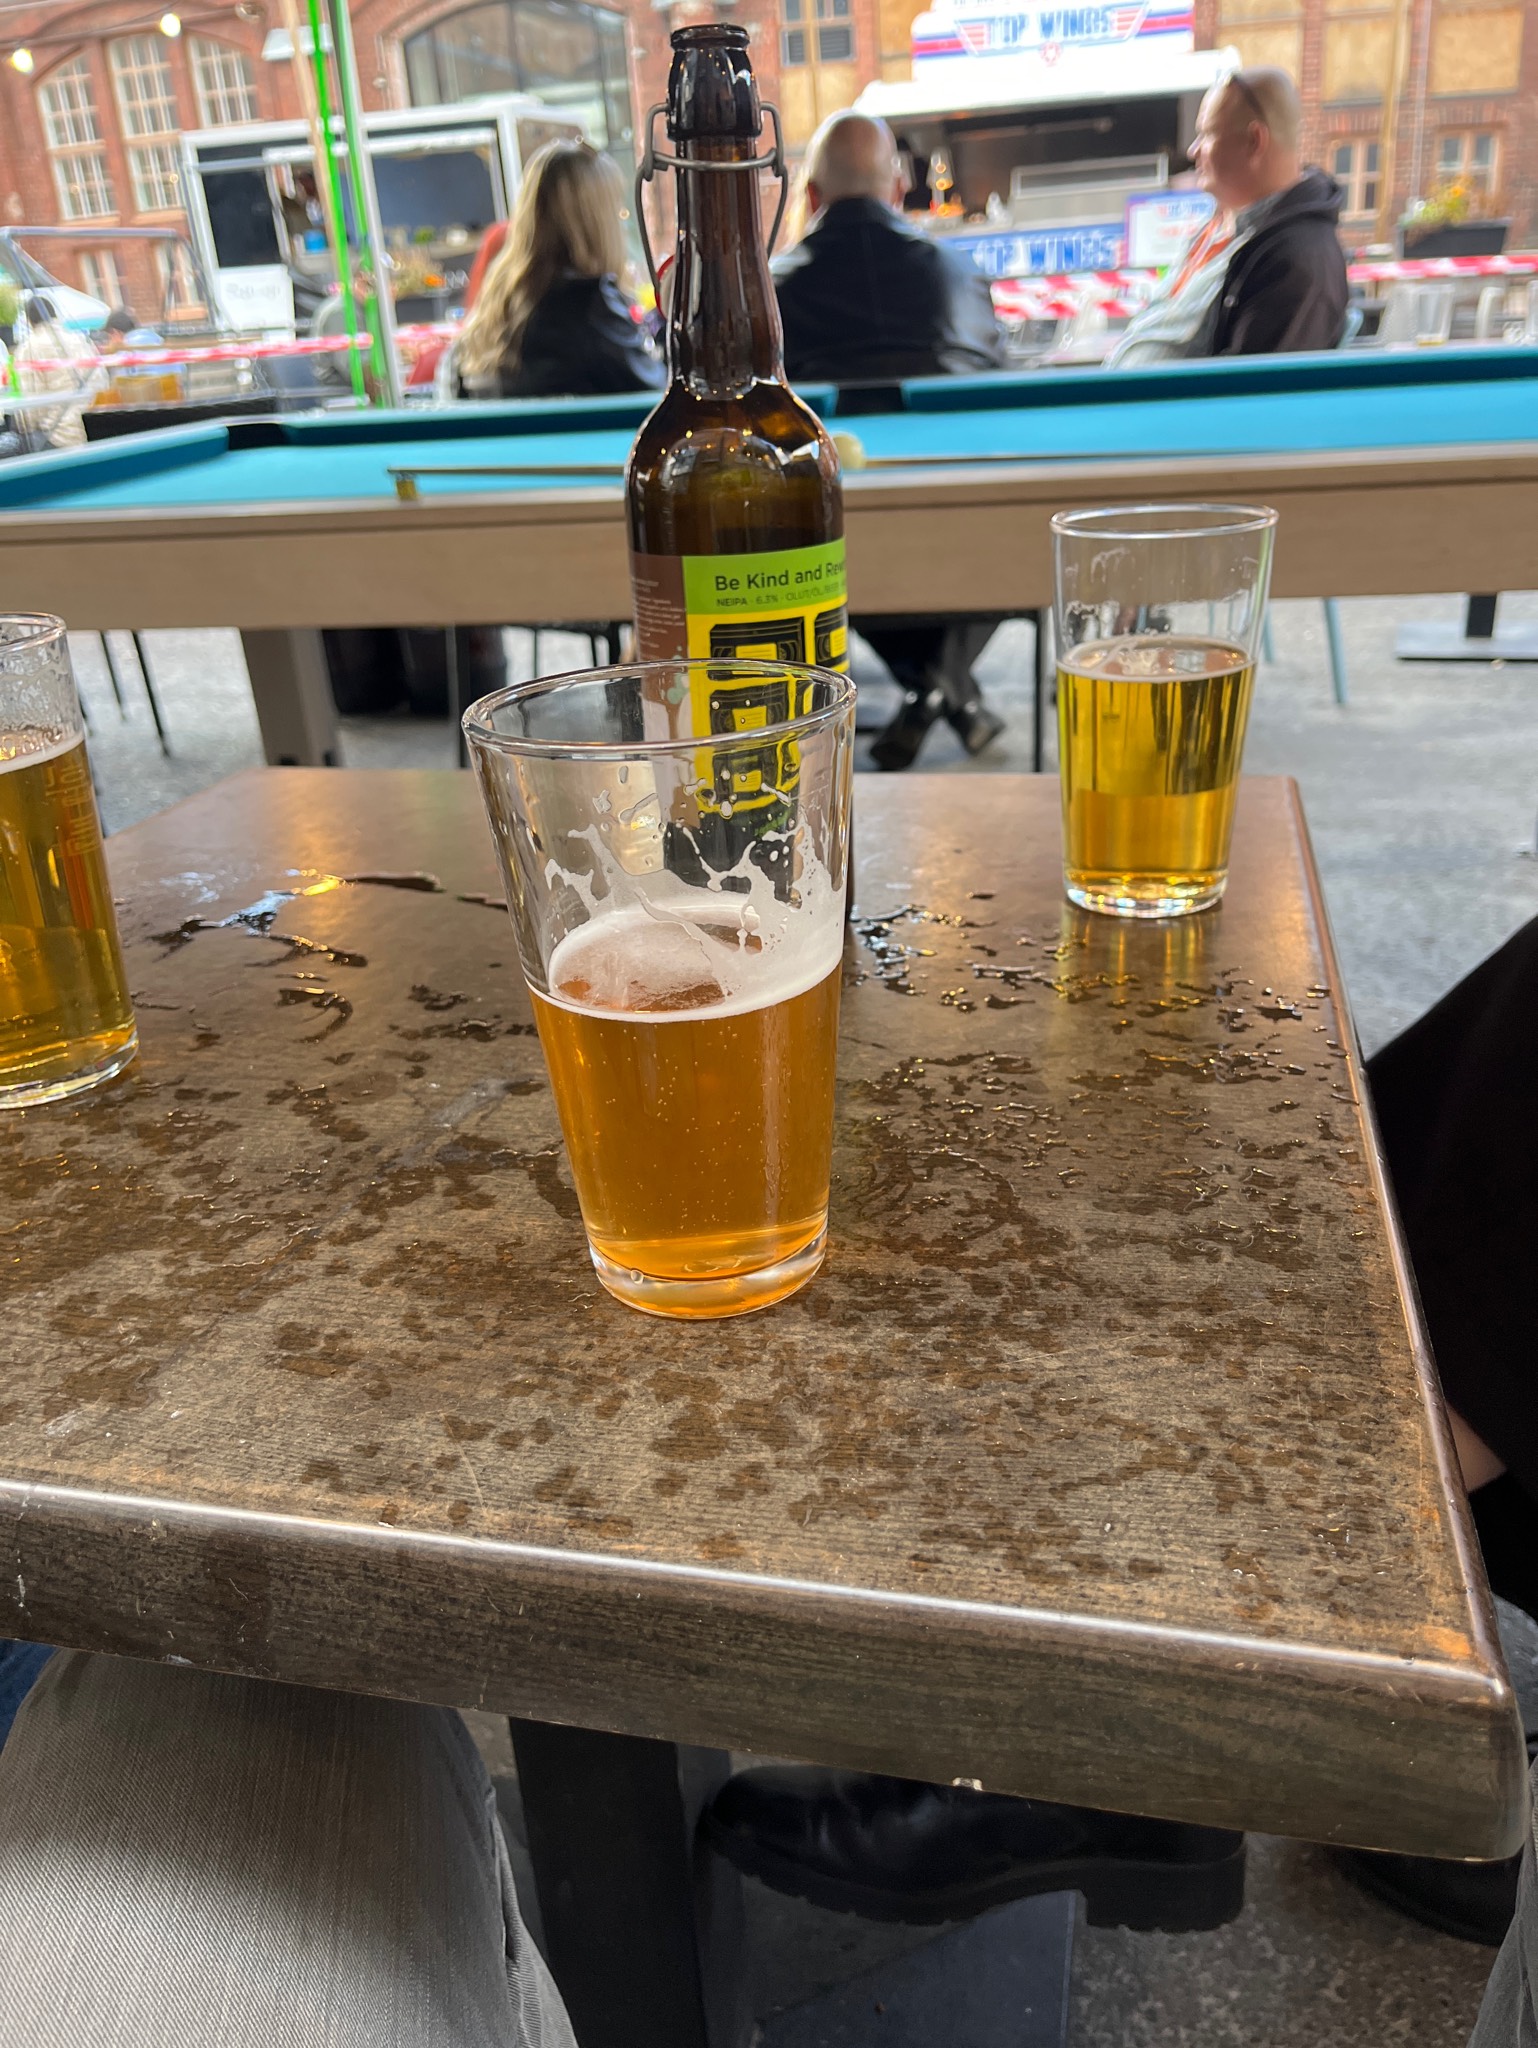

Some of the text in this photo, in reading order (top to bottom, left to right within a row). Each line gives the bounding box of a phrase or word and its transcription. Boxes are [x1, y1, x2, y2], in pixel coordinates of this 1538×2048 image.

[715, 575, 740, 591] Be
[747, 569, 789, 589] Kind
[795, 564, 822, 584] and
